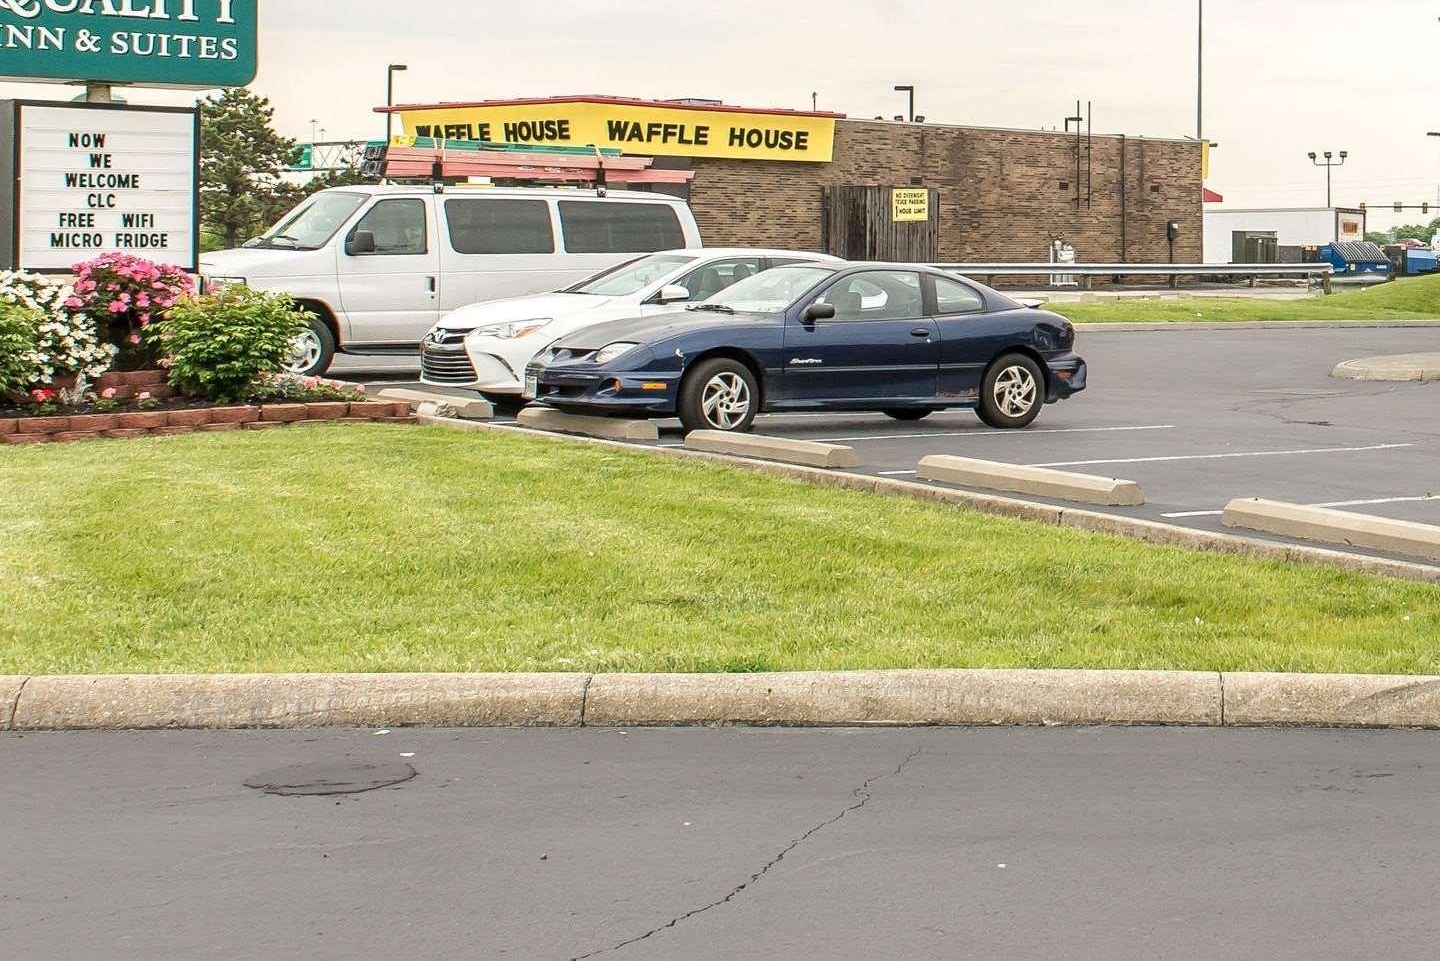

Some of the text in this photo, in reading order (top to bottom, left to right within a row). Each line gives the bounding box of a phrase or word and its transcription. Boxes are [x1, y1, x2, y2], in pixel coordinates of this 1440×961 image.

[0, 24, 238, 60] NN & SUITES
[416, 119, 571, 143] WAFFLE HOUSE
[607, 120, 809, 150] WAFFLE HOUSE
[69, 133, 106, 148] NOW
[90, 154, 112, 168] WE
[65, 173, 140, 188] WELCOME
[87, 194, 116, 208] CLC
[59, 213, 154, 228] FREE WIFI
[51, 233, 168, 248] MICRO FRIDGE
